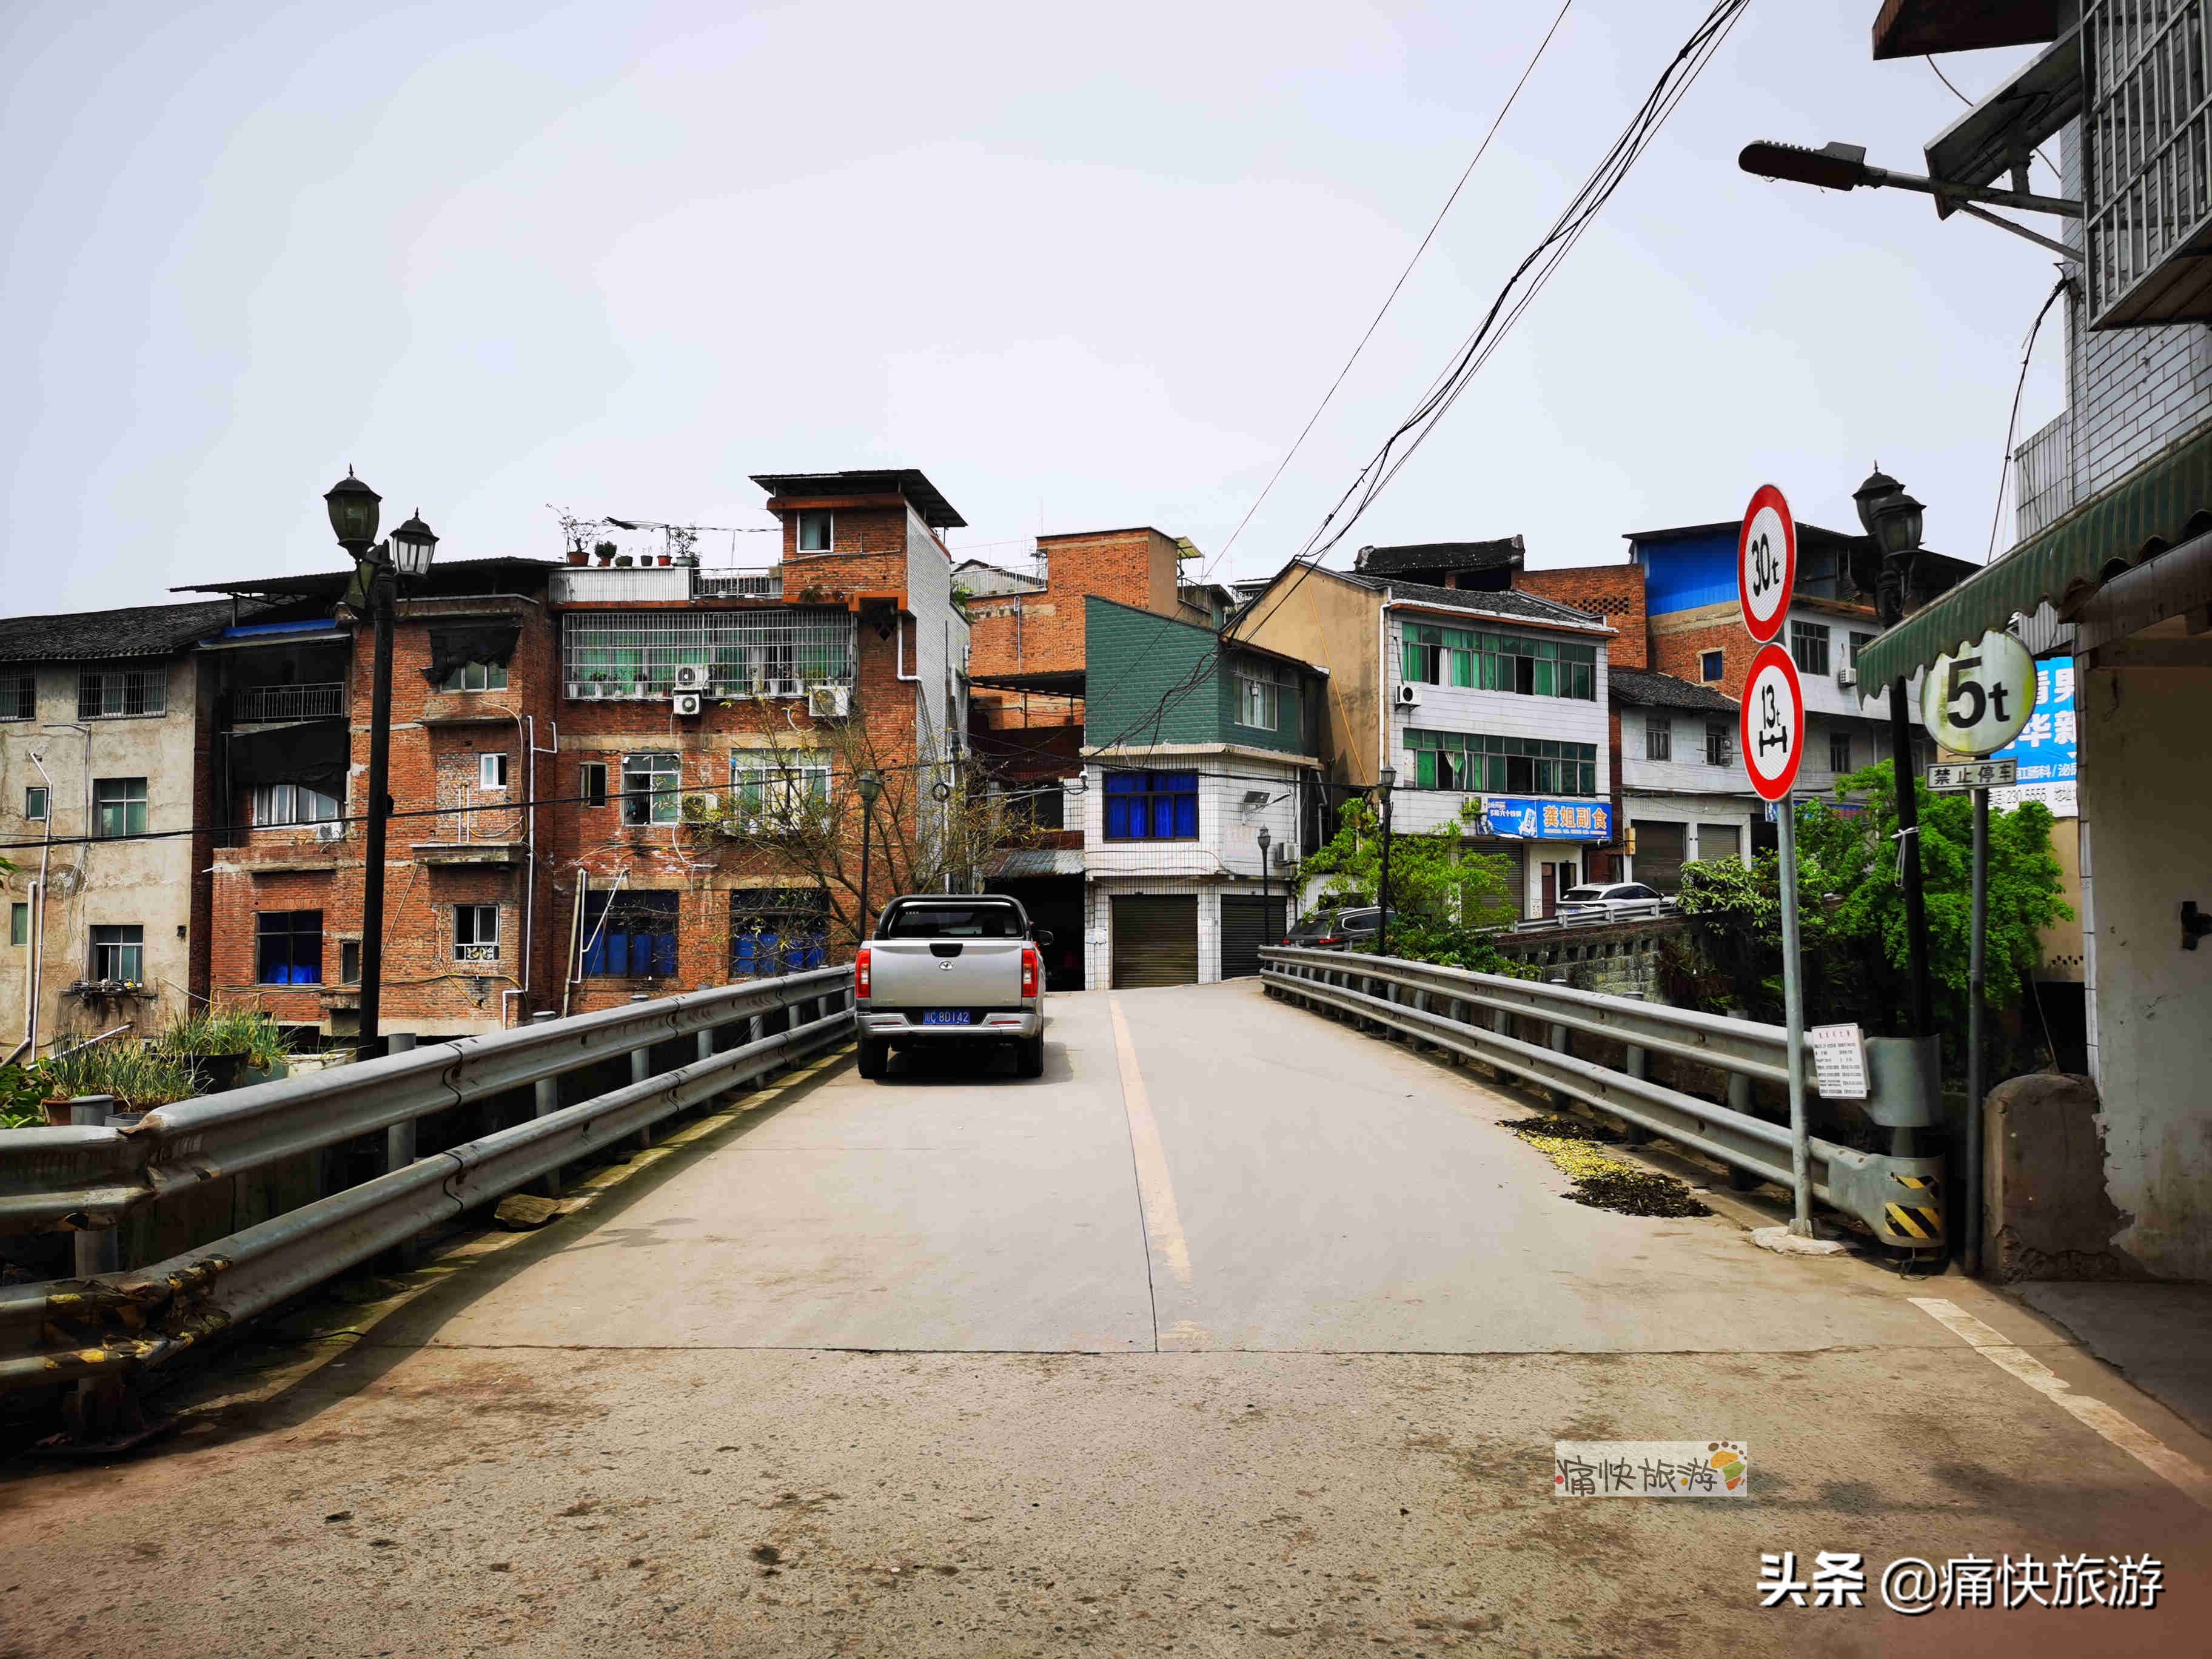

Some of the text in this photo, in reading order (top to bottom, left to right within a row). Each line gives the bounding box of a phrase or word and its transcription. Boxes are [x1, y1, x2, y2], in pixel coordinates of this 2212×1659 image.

[1751, 532, 1780, 597] 30t
[1761, 683, 1781, 730] 13t
[1947, 656, 2011, 729] 5t
[2003, 710, 2077, 749] 华新
[1934, 763, 2012, 785] 禁止停车
[1543, 805, 1607, 829] 龚姐副食
